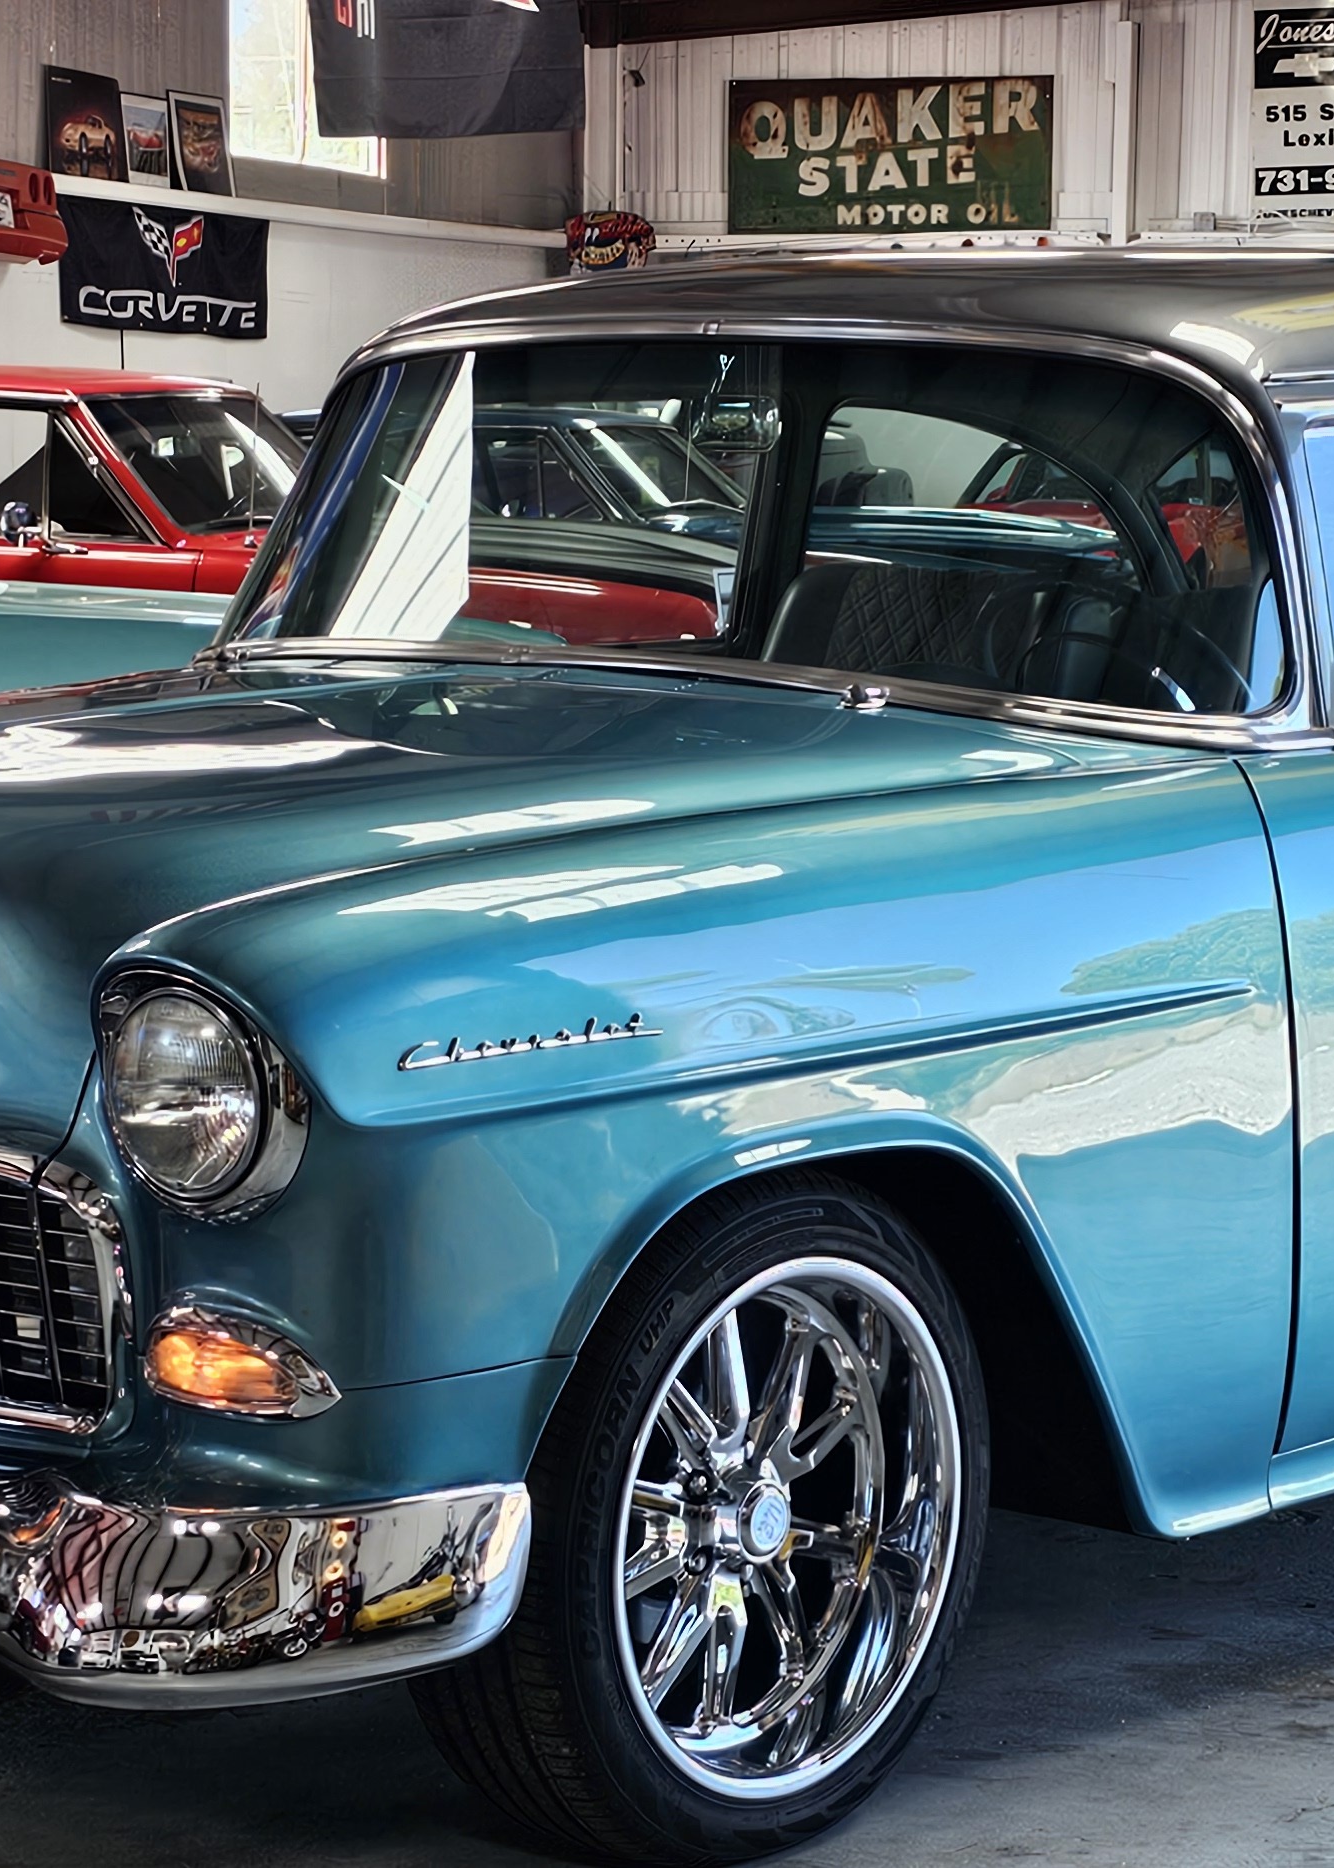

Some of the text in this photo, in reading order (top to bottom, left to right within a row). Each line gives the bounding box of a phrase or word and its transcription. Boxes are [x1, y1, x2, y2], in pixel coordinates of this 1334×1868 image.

[740, 79, 1040, 160] QUAKER
[1266, 104, 1307, 122] 515
[798, 145, 976, 196] STATE
[837, 204, 949, 226] MOTOR
[79, 285, 257, 328] CORVETTE
[397, 1012, 664, 1071] Chevrolet
